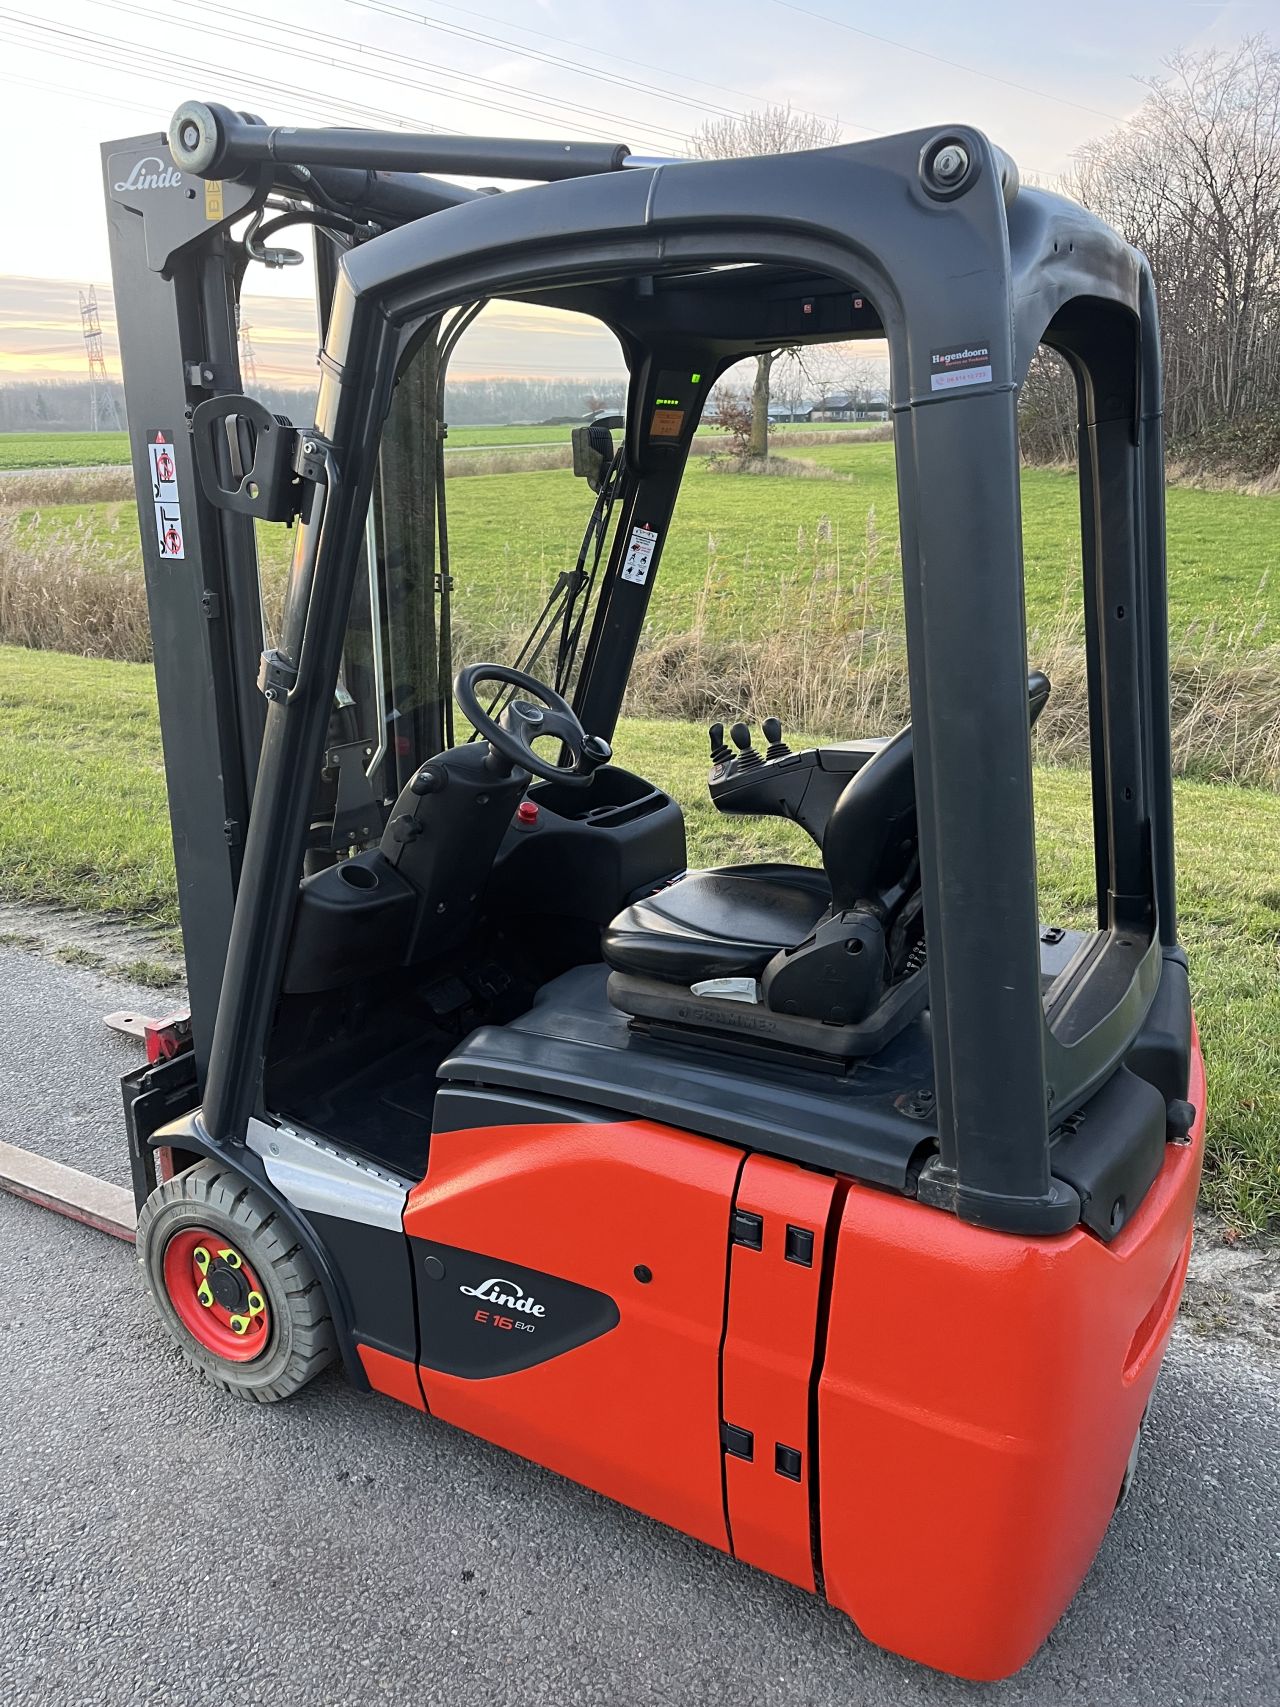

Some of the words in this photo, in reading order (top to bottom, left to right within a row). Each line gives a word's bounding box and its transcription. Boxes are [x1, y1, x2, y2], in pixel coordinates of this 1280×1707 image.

[114, 157, 181, 191] Linde
[459, 1278, 546, 1317] Linde
[474, 1309, 490, 1323] E
[493, 1314, 513, 1330] 16
[514, 1321, 535, 1333] EVO
